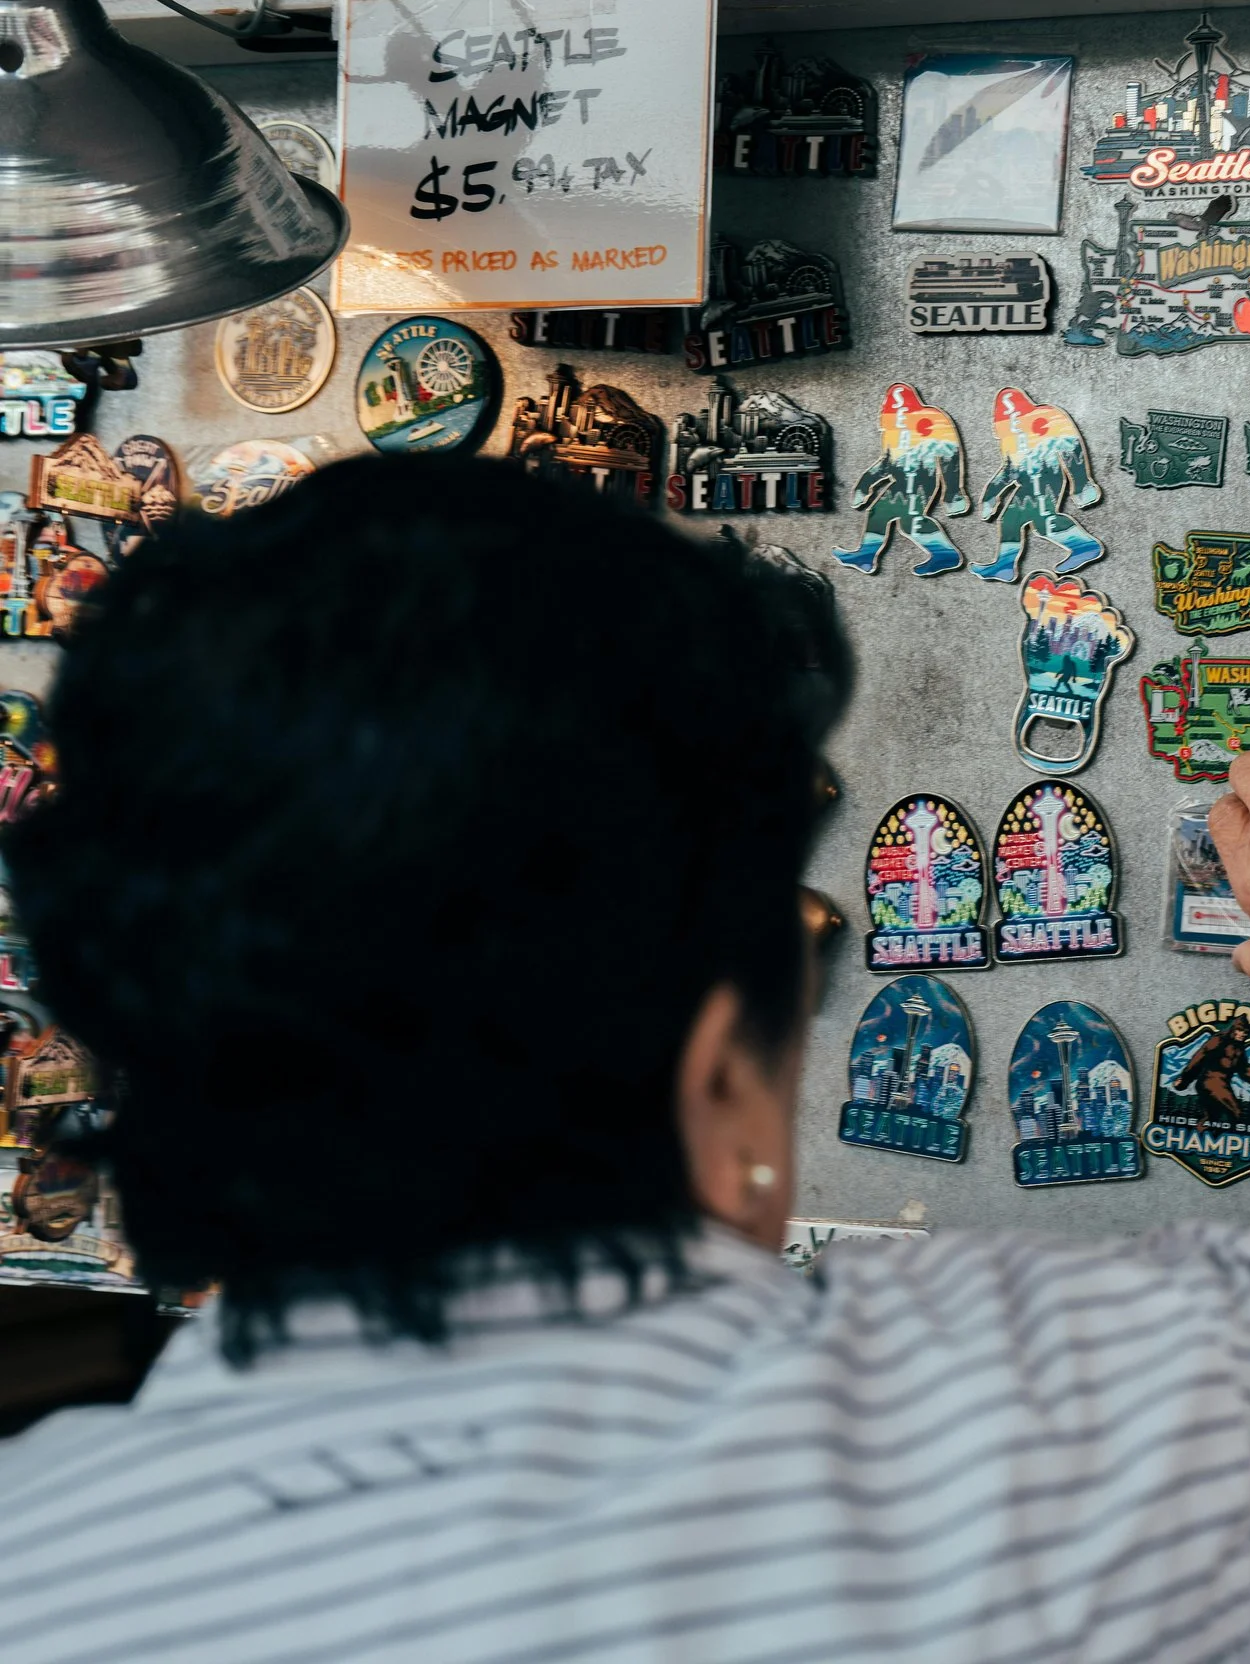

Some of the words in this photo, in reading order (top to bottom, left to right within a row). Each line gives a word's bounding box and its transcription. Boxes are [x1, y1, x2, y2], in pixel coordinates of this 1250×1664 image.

[427, 27, 628, 83] SEATTLE
[423, 88, 603, 140] MAGNET
[581, 148, 653, 191] TAX
[442, 250, 518, 273] PRICED
[530, 250, 559, 272] AS
[571, 245, 668, 273] MARKED
[910, 303, 1043, 328] SEATTLE
[376, 325, 438, 362] SEATTLE
[684, 308, 843, 371] SEATTLE
[1151, 413, 1223, 431] WASHINGTON
[667, 472, 826, 511] SEATTLE
[1027, 691, 1091, 719] SEATTLE
[872, 933, 983, 964] SEATTLE
[1001, 918, 1113, 951] SEATTLE
[843, 1107, 960, 1156] SEATTLE
[1158, 1114, 1197, 1126] HIDE
[1202, 1119, 1231, 1130] AND
[1018, 1141, 1136, 1181] SEATTLE
[1199, 1157, 1233, 1168] SINCE
